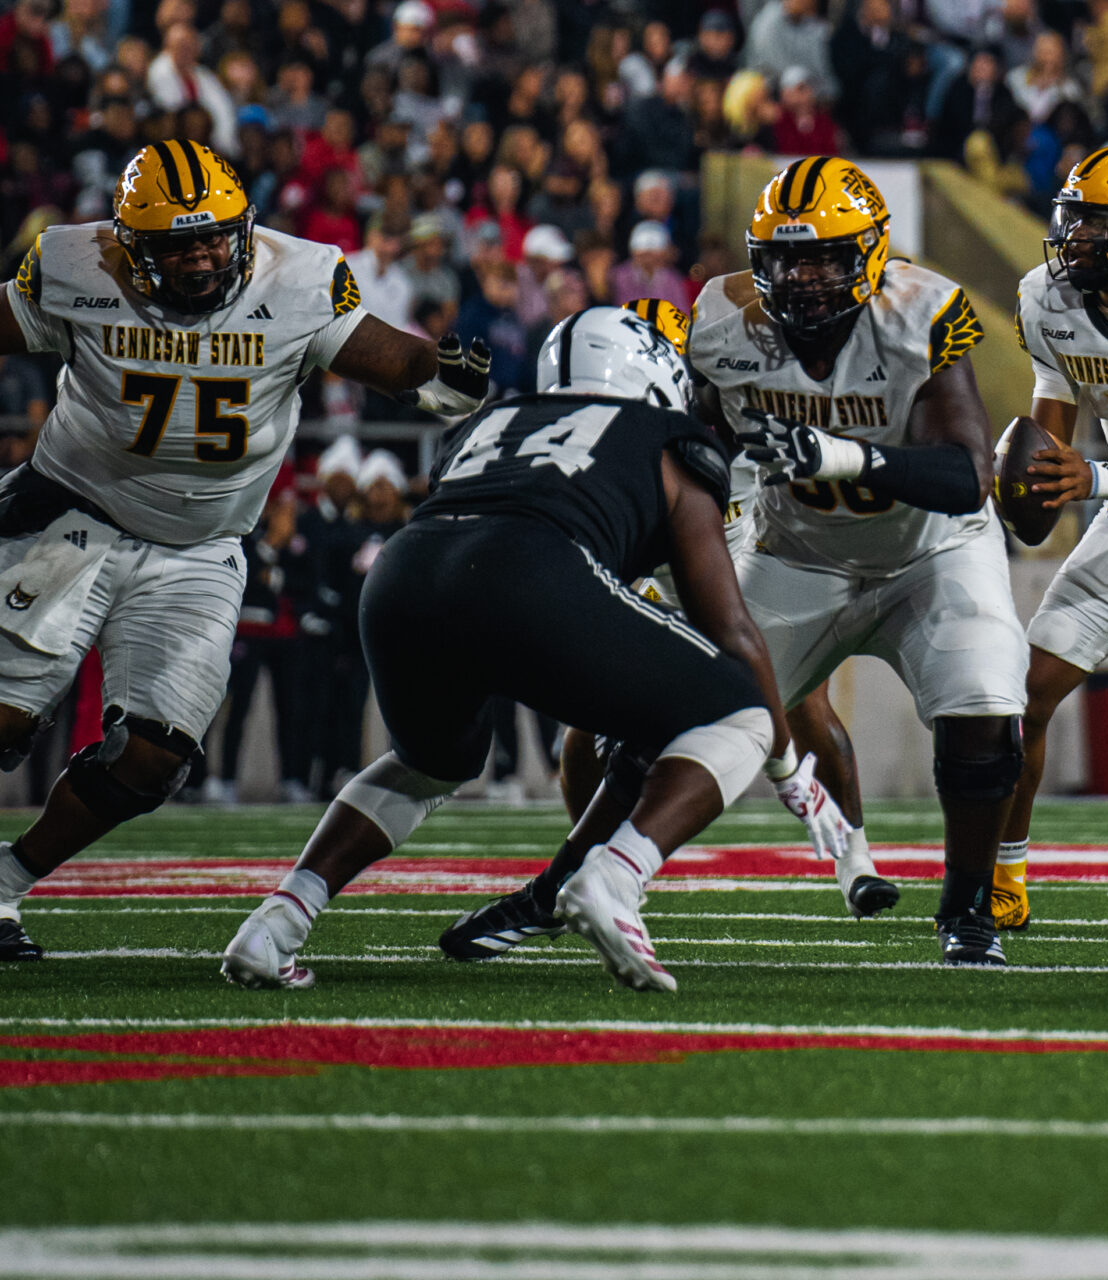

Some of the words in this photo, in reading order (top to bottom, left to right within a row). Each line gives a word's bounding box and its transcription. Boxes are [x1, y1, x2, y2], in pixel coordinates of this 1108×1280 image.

[101, 324, 201, 365] KENNESAW
[210, 332, 265, 367] STATE
[121, 370, 251, 462] 75
[833, 391, 888, 427] STATE
[440, 403, 623, 482] 44
